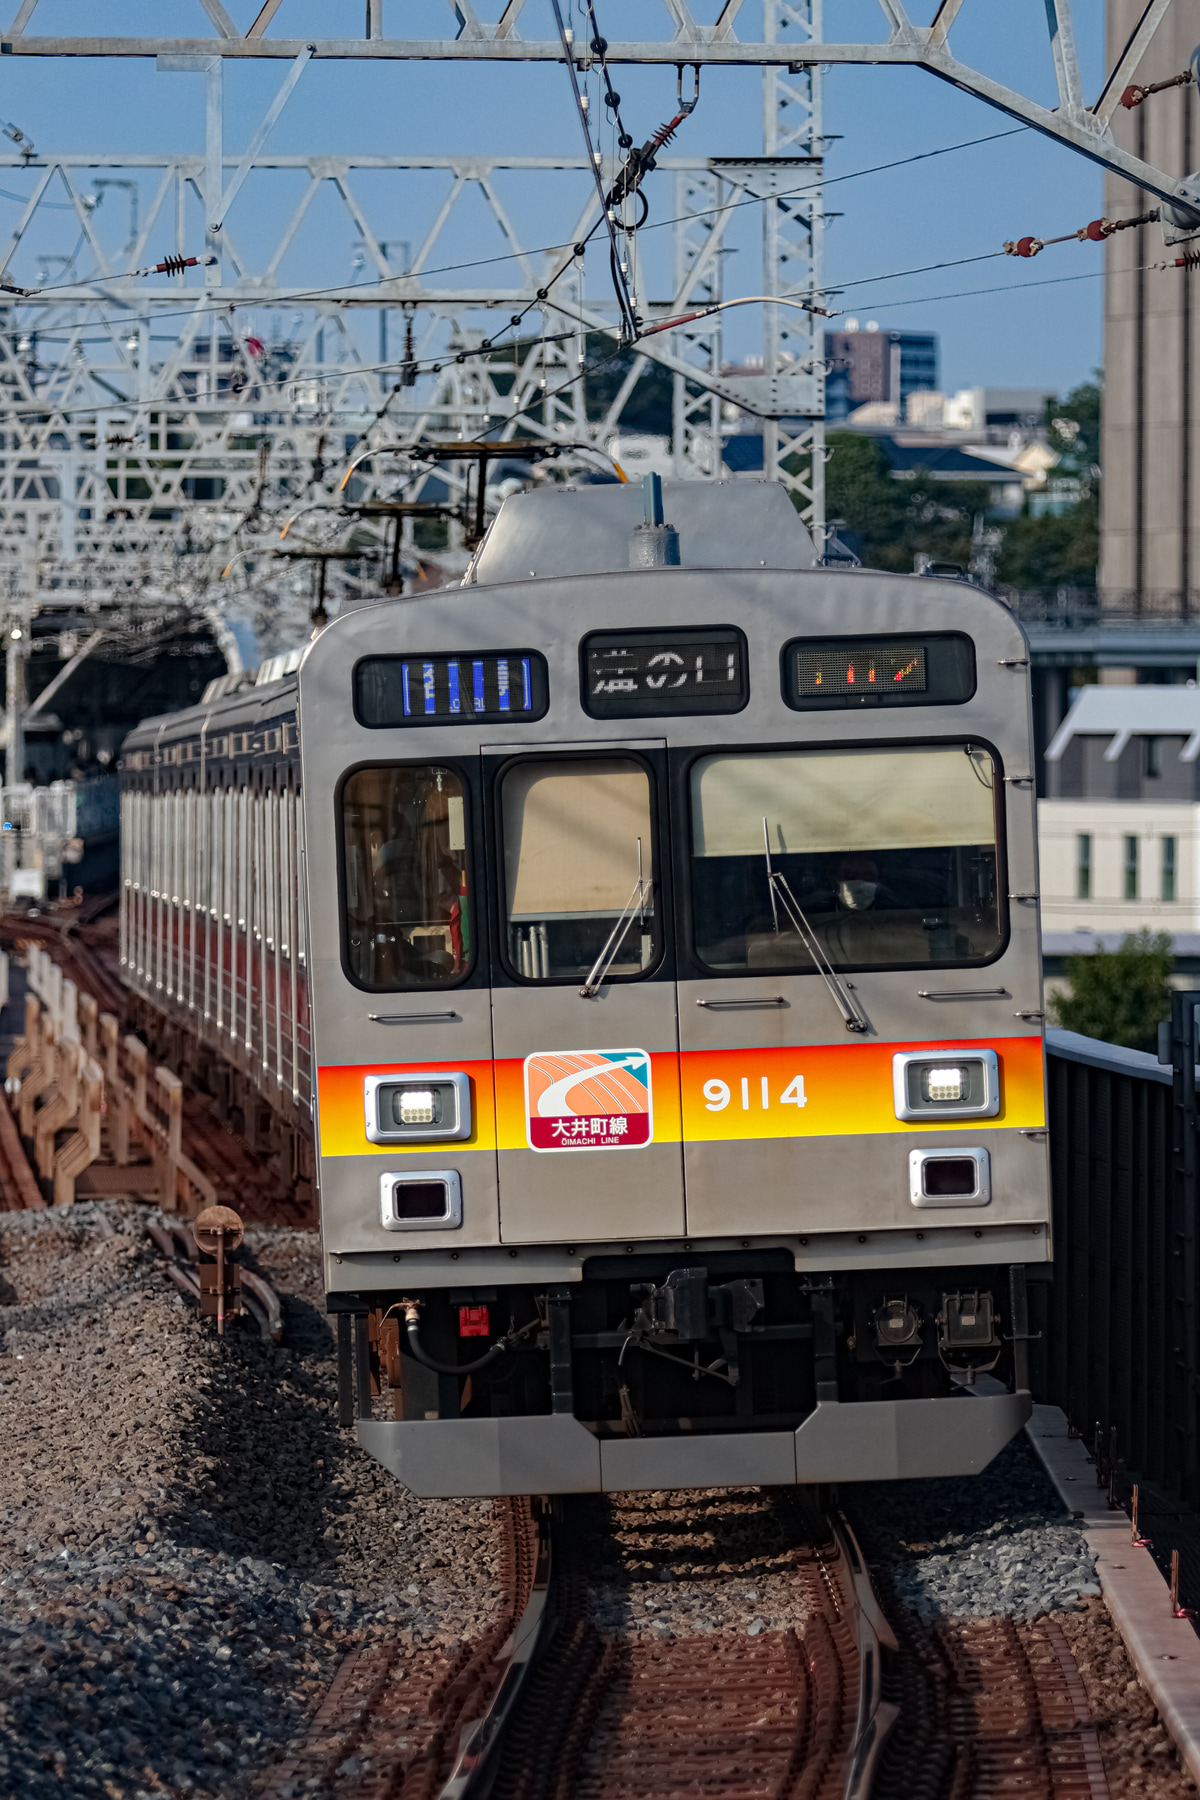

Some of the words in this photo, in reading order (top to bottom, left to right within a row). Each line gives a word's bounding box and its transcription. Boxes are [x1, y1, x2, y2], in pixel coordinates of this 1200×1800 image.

[702, 1075, 808, 1112] 9114
[551, 1116, 628, 1137] 大井町線
[600, 1136, 620, 1144] LINE
